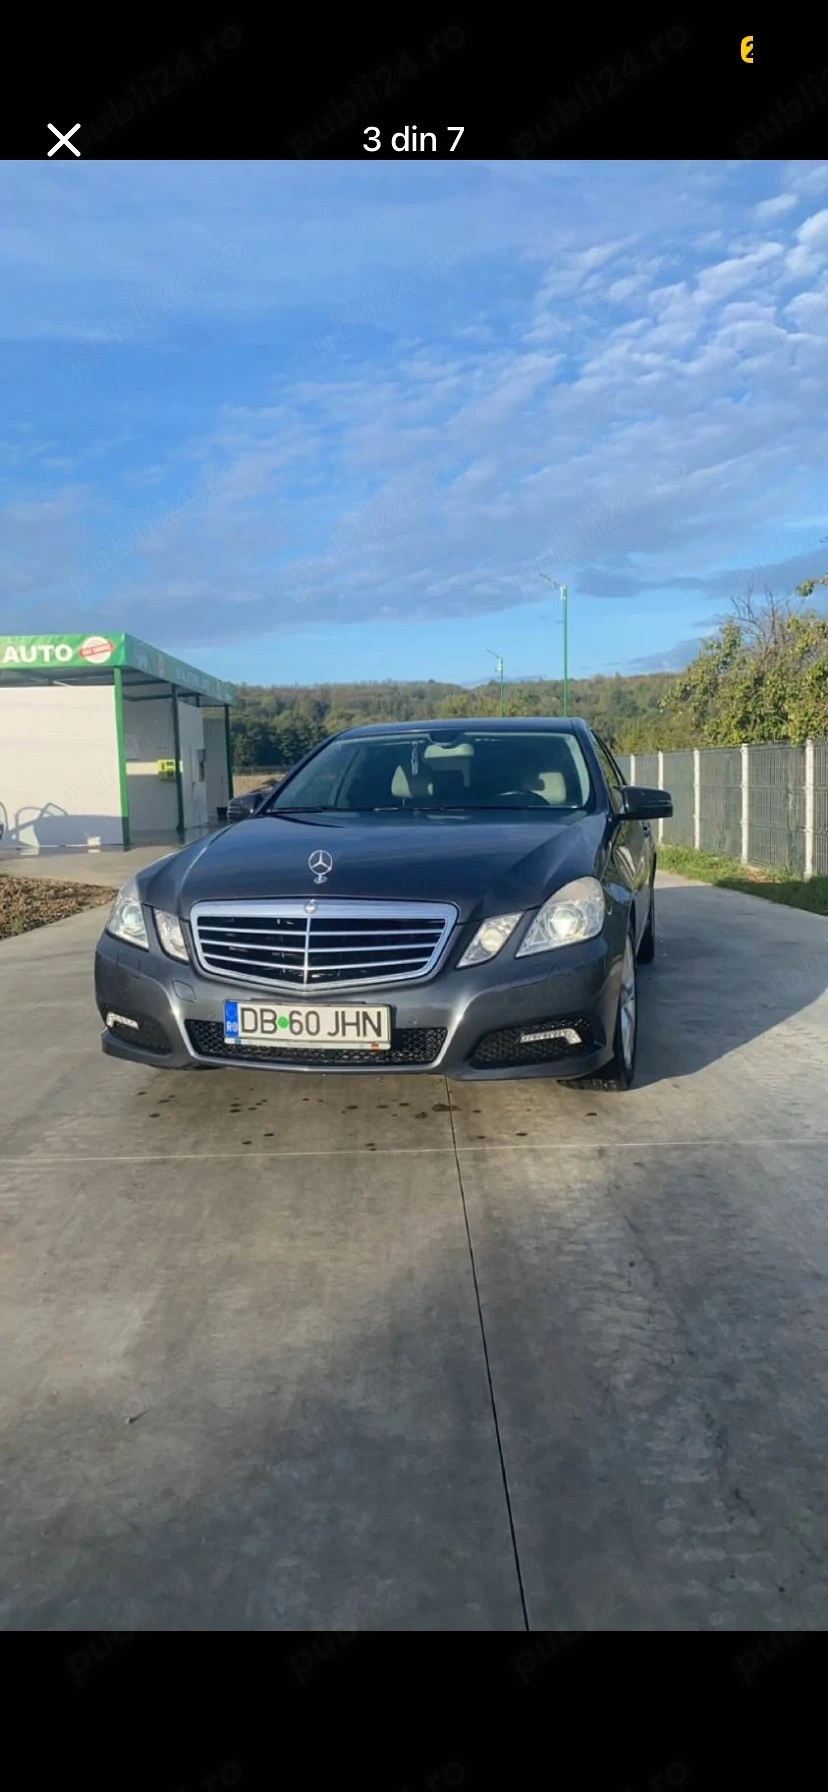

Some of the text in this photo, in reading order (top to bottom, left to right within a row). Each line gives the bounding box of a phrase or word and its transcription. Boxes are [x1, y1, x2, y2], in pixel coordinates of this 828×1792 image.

[2, 643, 73, 665] AUTO
[226, 1021, 238, 1033] RO
[240, 1007, 382, 1038] DB 60 JHN
